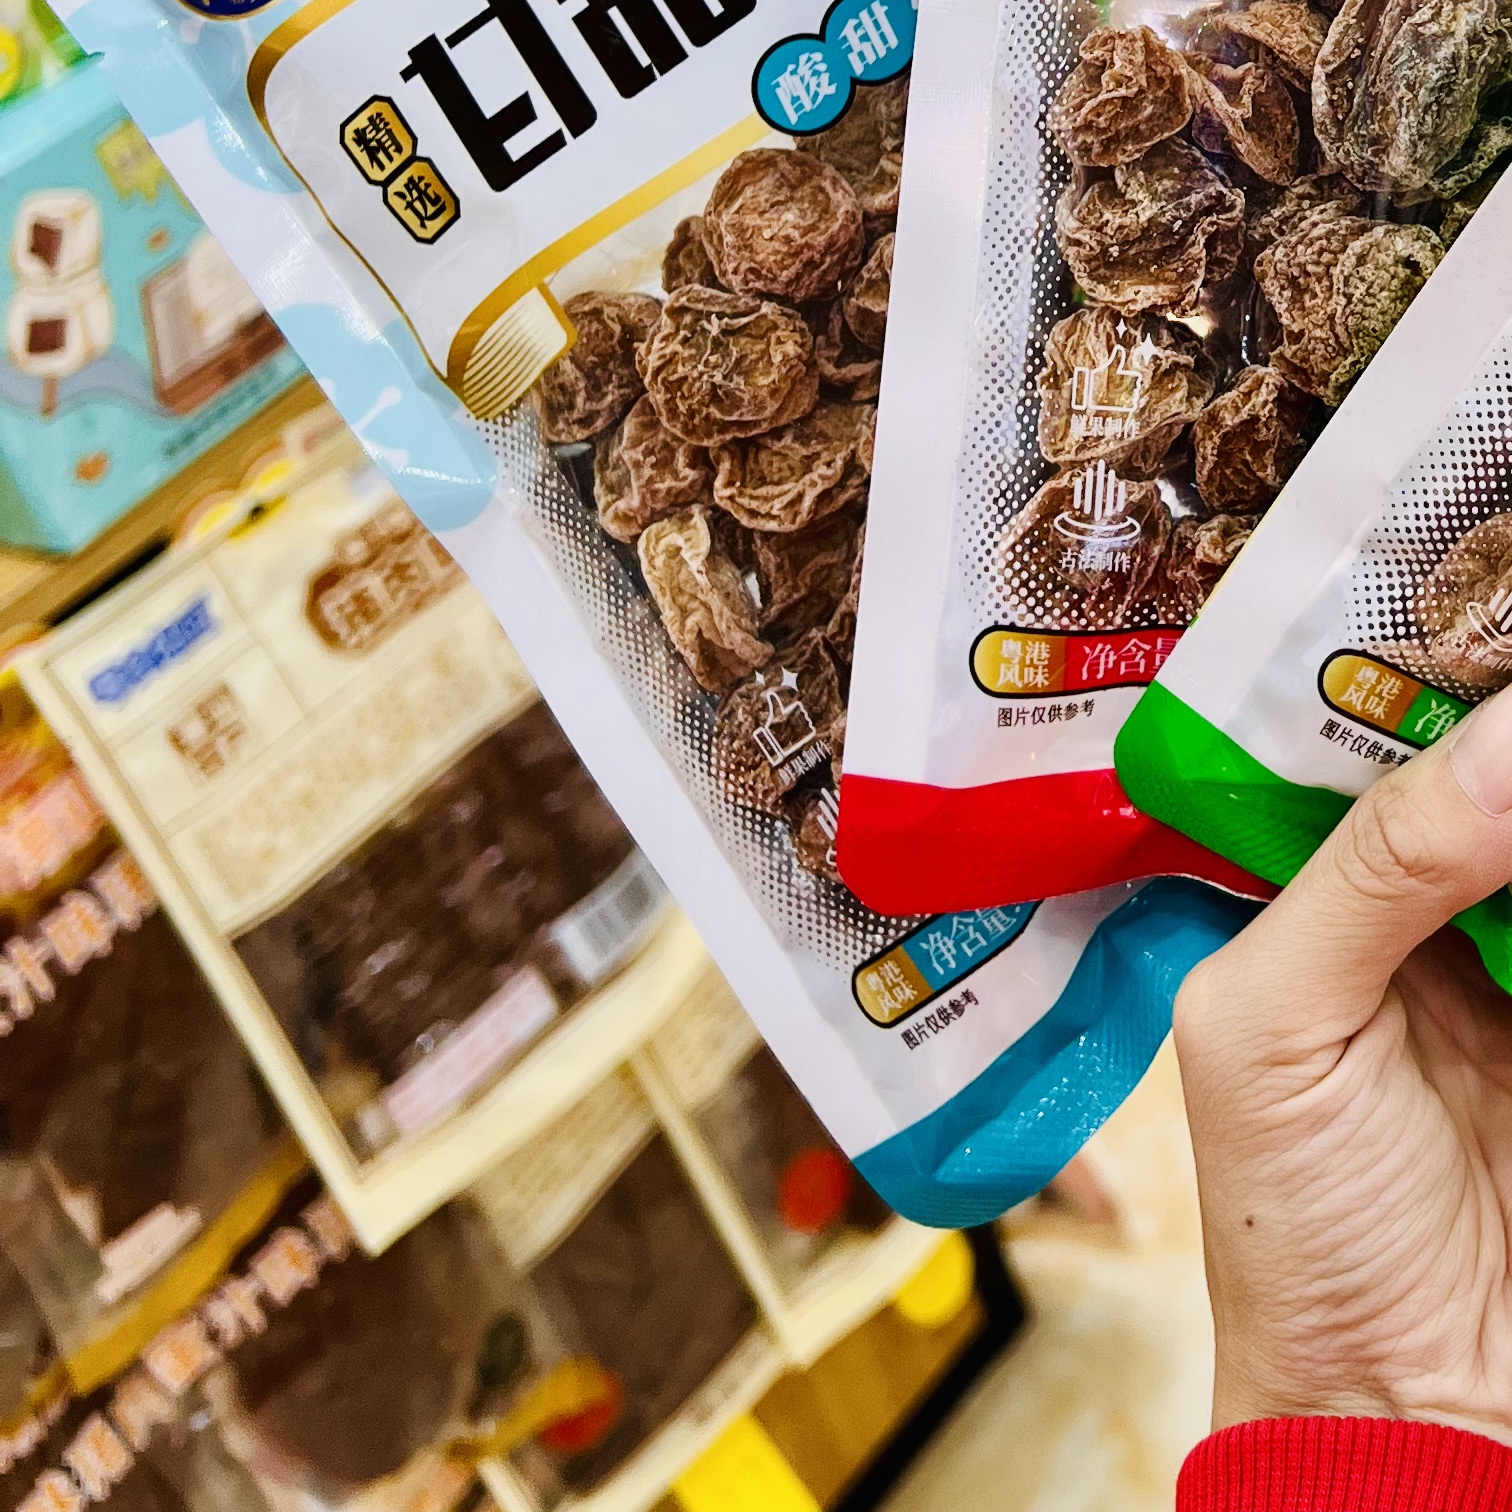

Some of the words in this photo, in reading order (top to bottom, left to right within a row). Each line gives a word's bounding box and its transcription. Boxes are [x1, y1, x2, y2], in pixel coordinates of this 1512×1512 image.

[351, 112, 448, 227] 精选
[1002, 638, 1051, 666] 粤港
[996, 664, 1050, 688] 风味
[1355, 665, 1404, 700] 粤港
[997, 699, 1095, 728] 图片仅供参考
[1339, 684, 1391, 720] 风味
[865, 959, 905, 993] 粤港
[876, 980, 919, 1018] 风味
[900, 988, 980, 1051] 图片仅供参考
